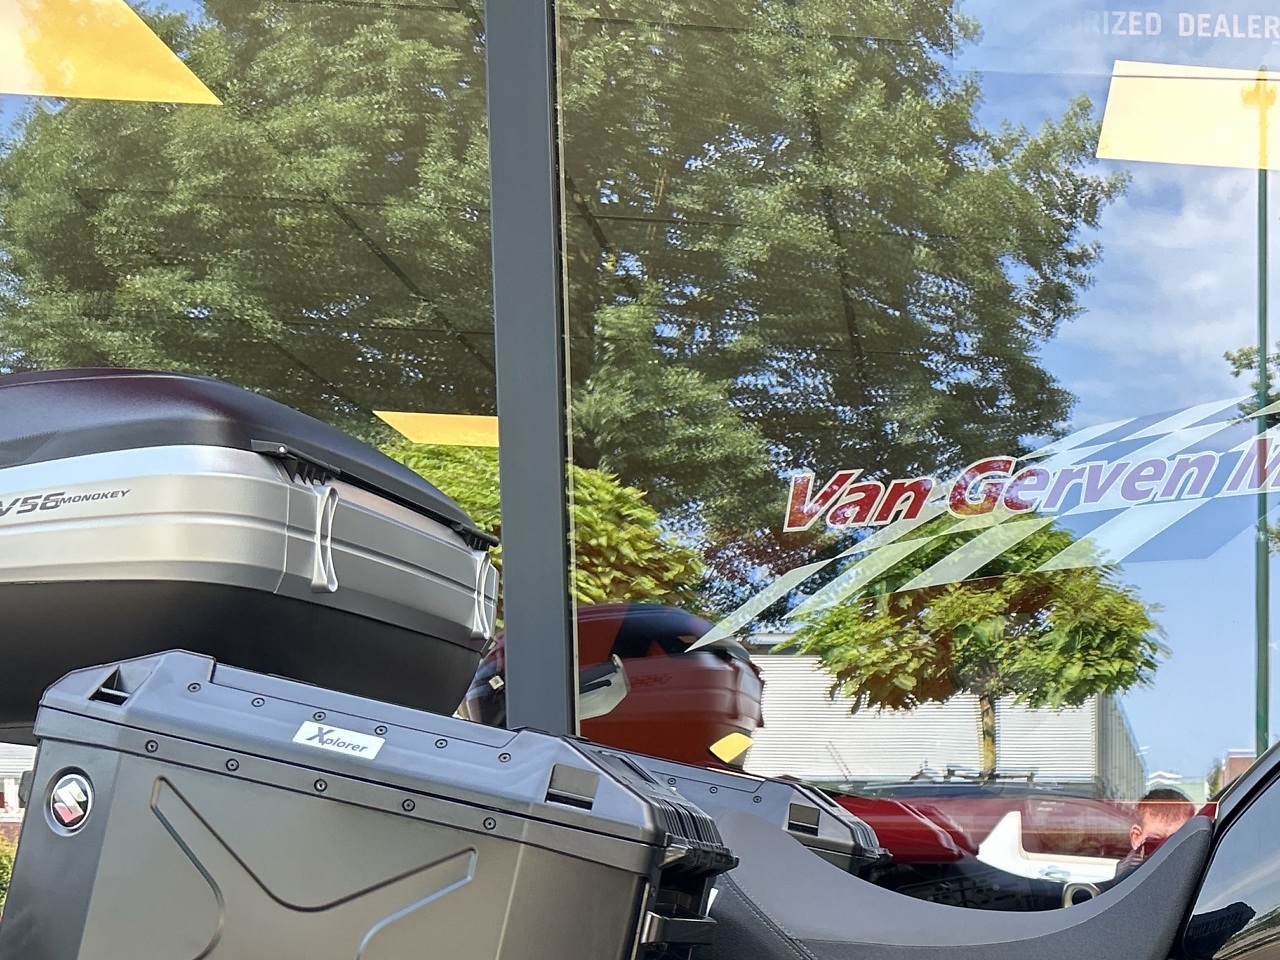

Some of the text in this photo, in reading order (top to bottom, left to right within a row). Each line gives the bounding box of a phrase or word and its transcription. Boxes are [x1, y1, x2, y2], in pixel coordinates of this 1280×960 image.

[1081, 10, 1280, 39] RIZED DEALER
[60, 489, 131, 505] MONOKEY
[783, 468, 935, 532] Van
[949, 451, 1223, 519] Gerven
[305, 726, 368, 753] Xplorer
